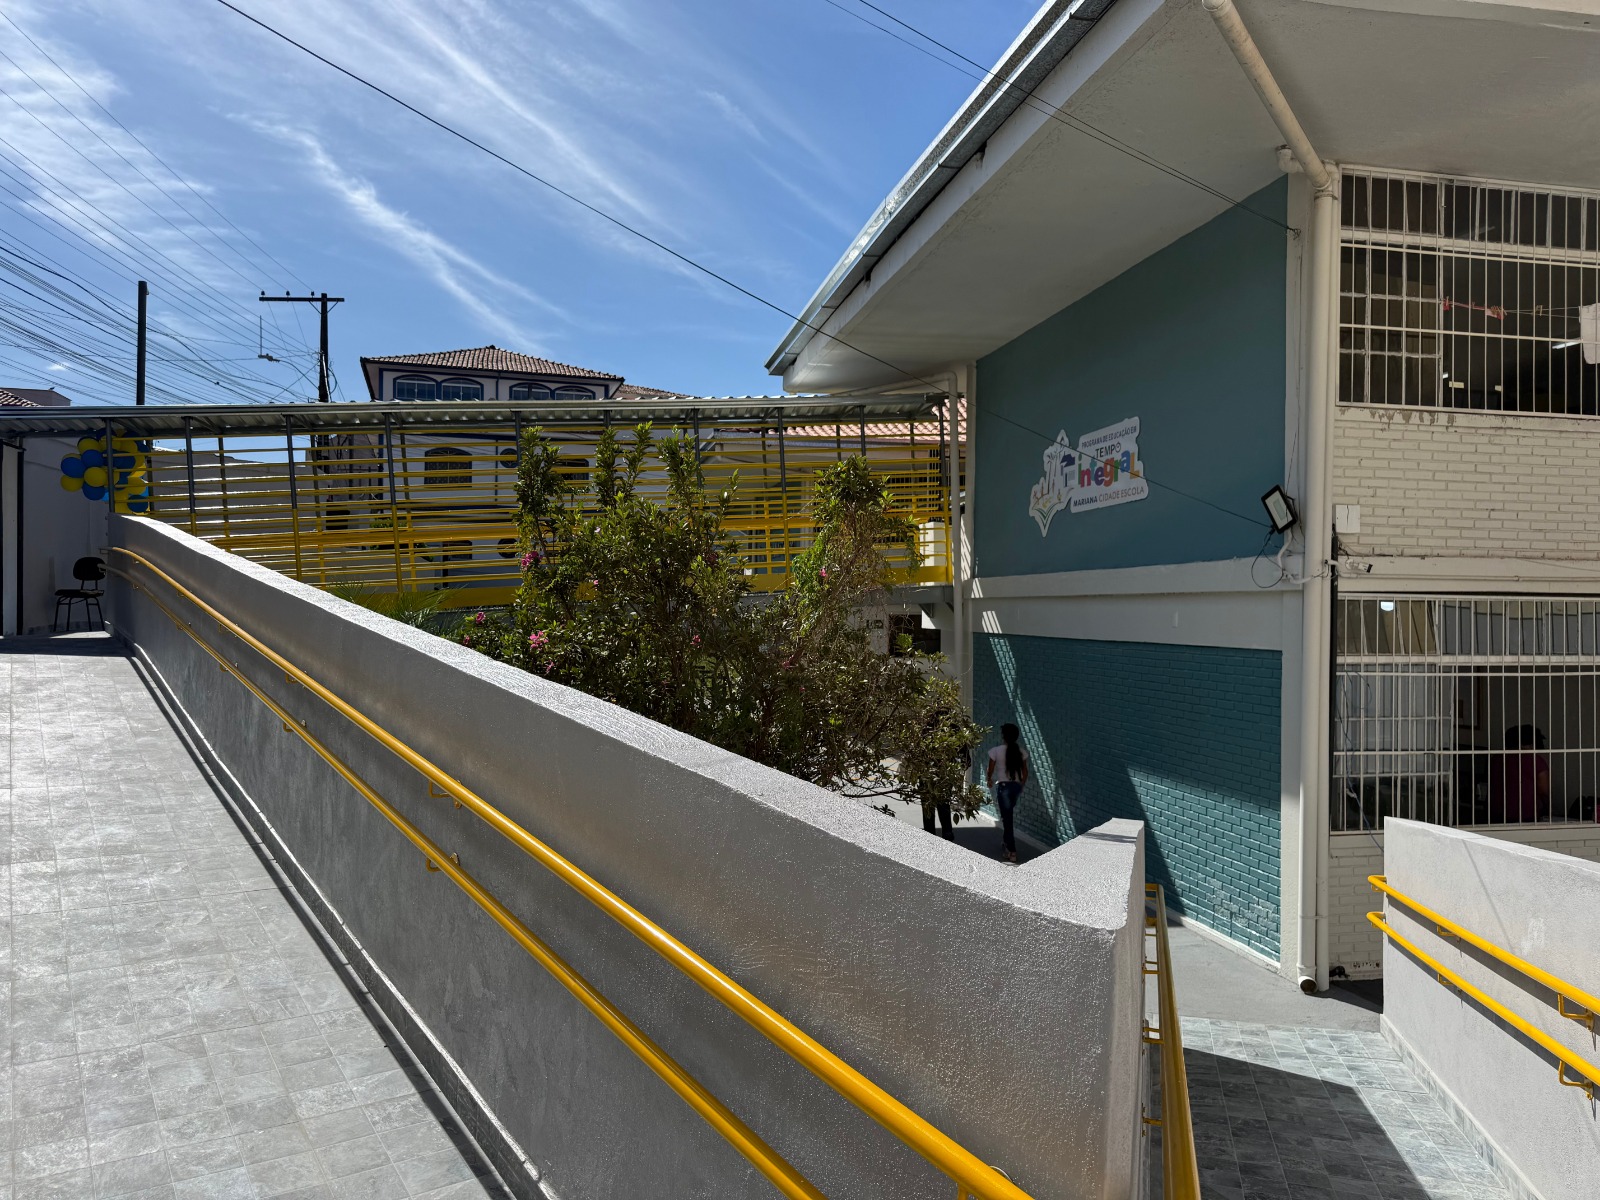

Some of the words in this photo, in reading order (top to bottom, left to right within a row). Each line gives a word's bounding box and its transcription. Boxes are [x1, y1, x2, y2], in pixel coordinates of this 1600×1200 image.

[1095, 442, 1121, 458] TEMPO
[1073, 496, 1098, 507] MARIANA
[1098, 490, 1120, 503] CIDADE
[1120, 486, 1144, 498] ESCOLA
